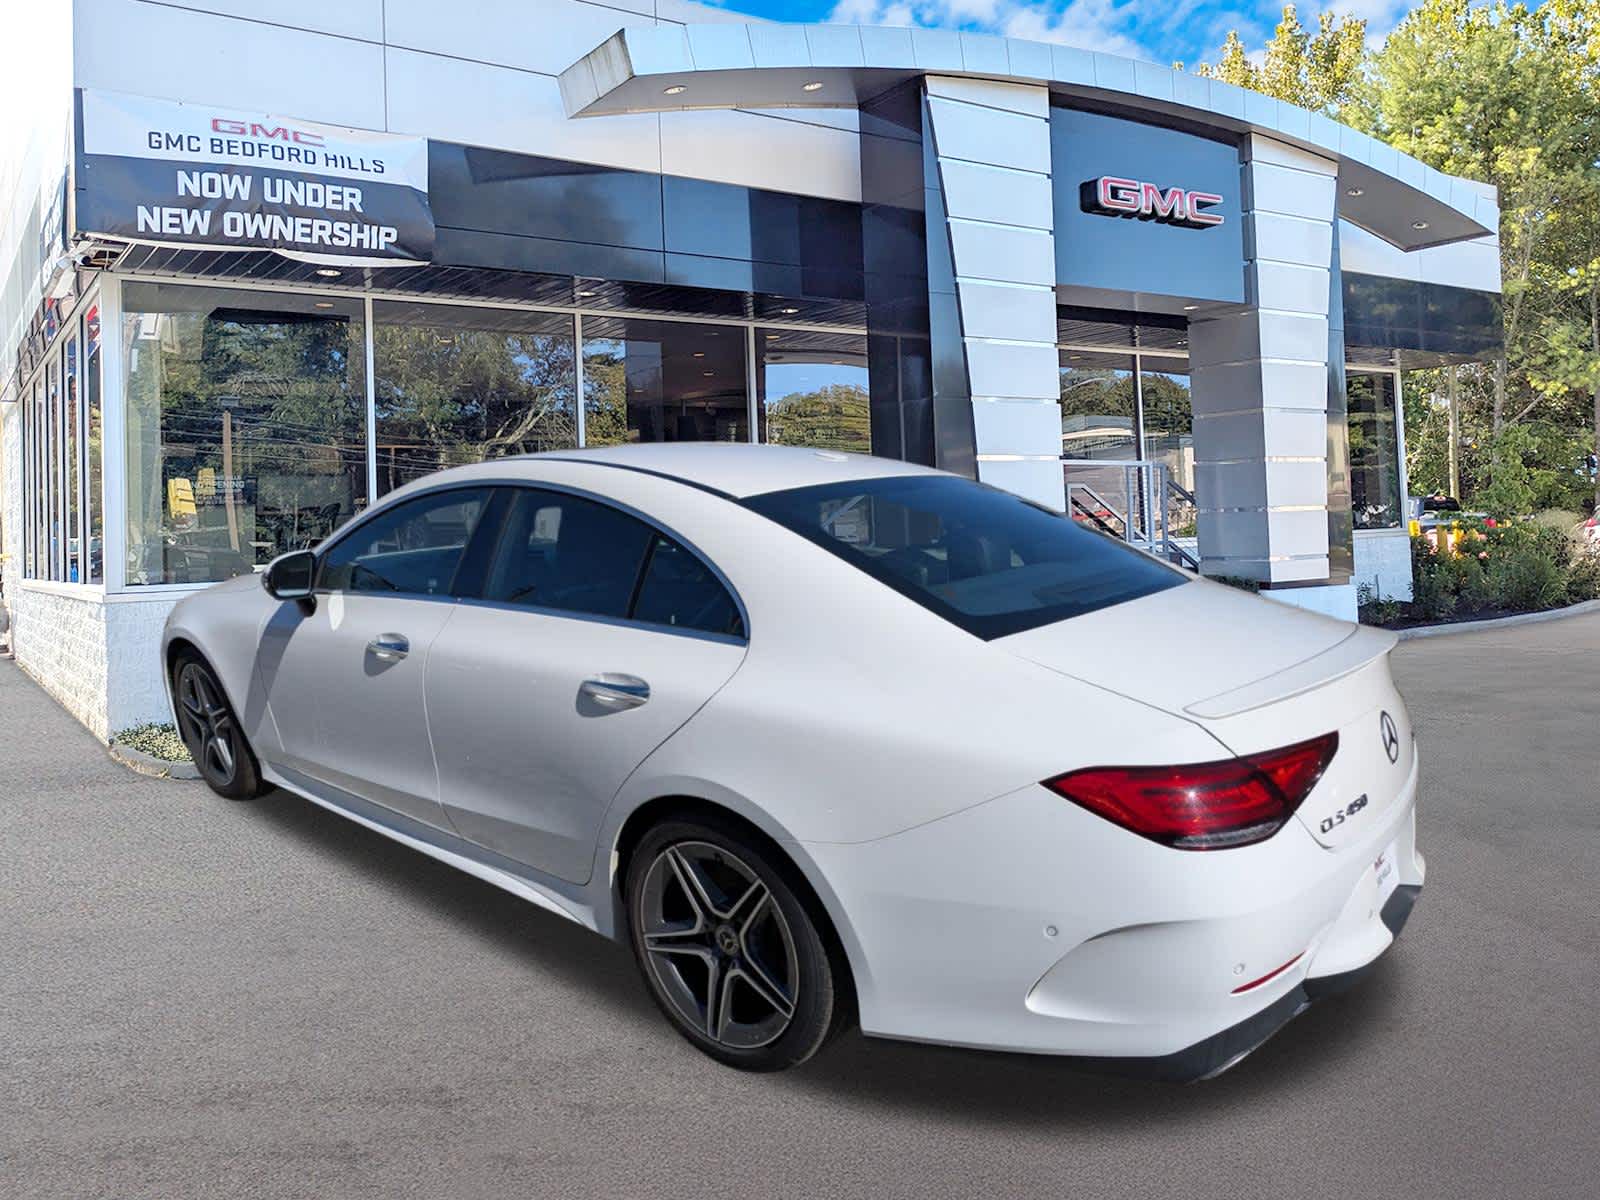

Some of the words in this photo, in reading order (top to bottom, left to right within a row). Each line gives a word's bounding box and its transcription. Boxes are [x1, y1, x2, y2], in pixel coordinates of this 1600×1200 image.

[148, 131, 202, 153] GMC
[210, 138, 317, 166] BEDFORD
[324, 153, 386, 174] HILLS
[212, 118, 326, 148] GMC
[176, 170, 253, 201] NOW
[263, 177, 364, 213] UNDER
[1095, 175, 1225, 226] GMC
[136, 205, 212, 236] NEW
[223, 211, 398, 250] OWNERSHIP
